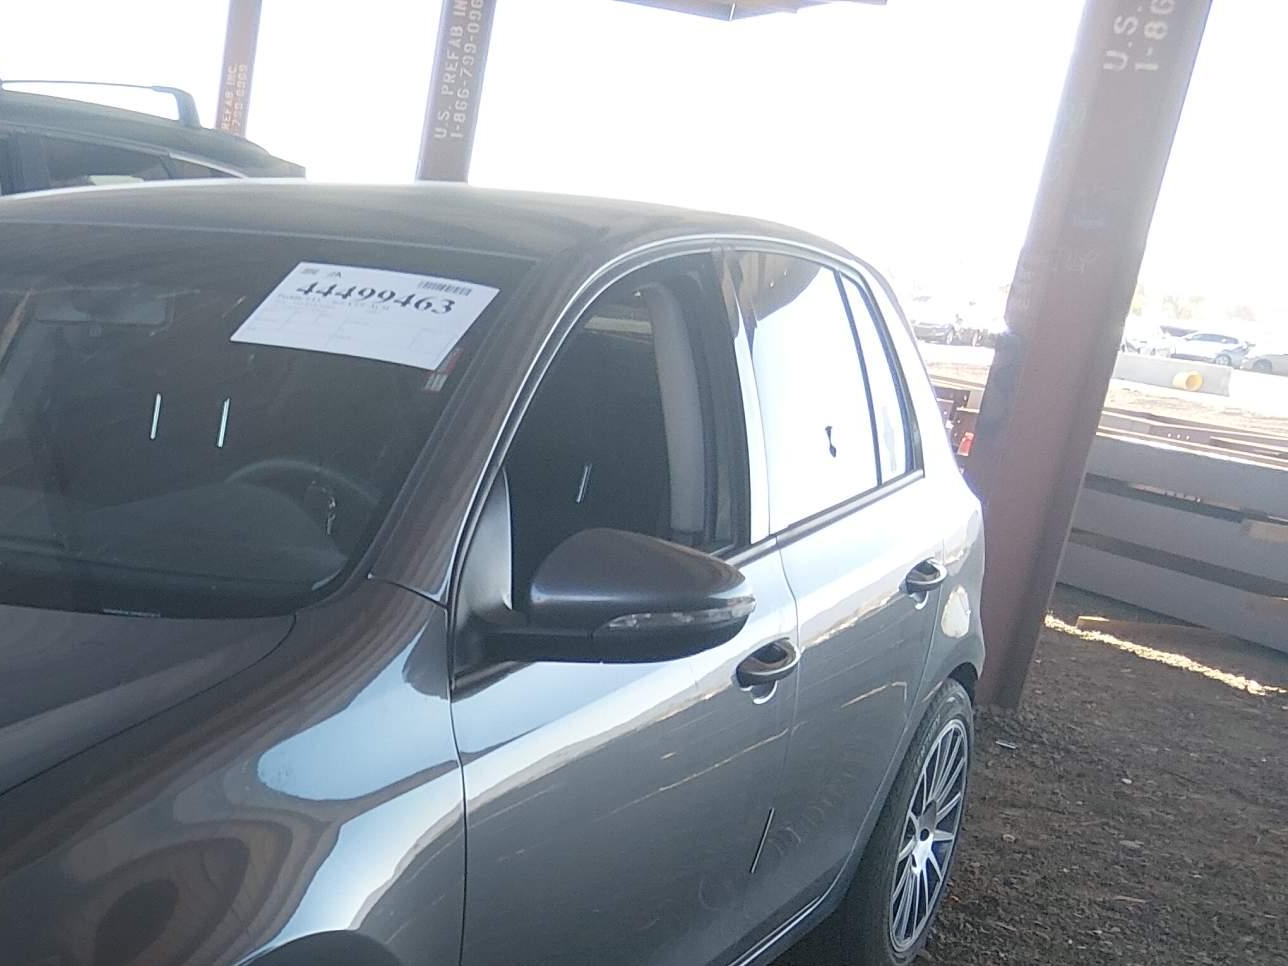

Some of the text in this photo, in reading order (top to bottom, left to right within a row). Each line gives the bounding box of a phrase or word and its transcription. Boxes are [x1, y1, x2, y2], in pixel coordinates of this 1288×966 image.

[440, 25, 464, 95] PREFAB
[1103, 5, 1144, 72] U.S.
[434, 105, 454, 139] U.S.
[296, 280, 456, 316] 44499463
